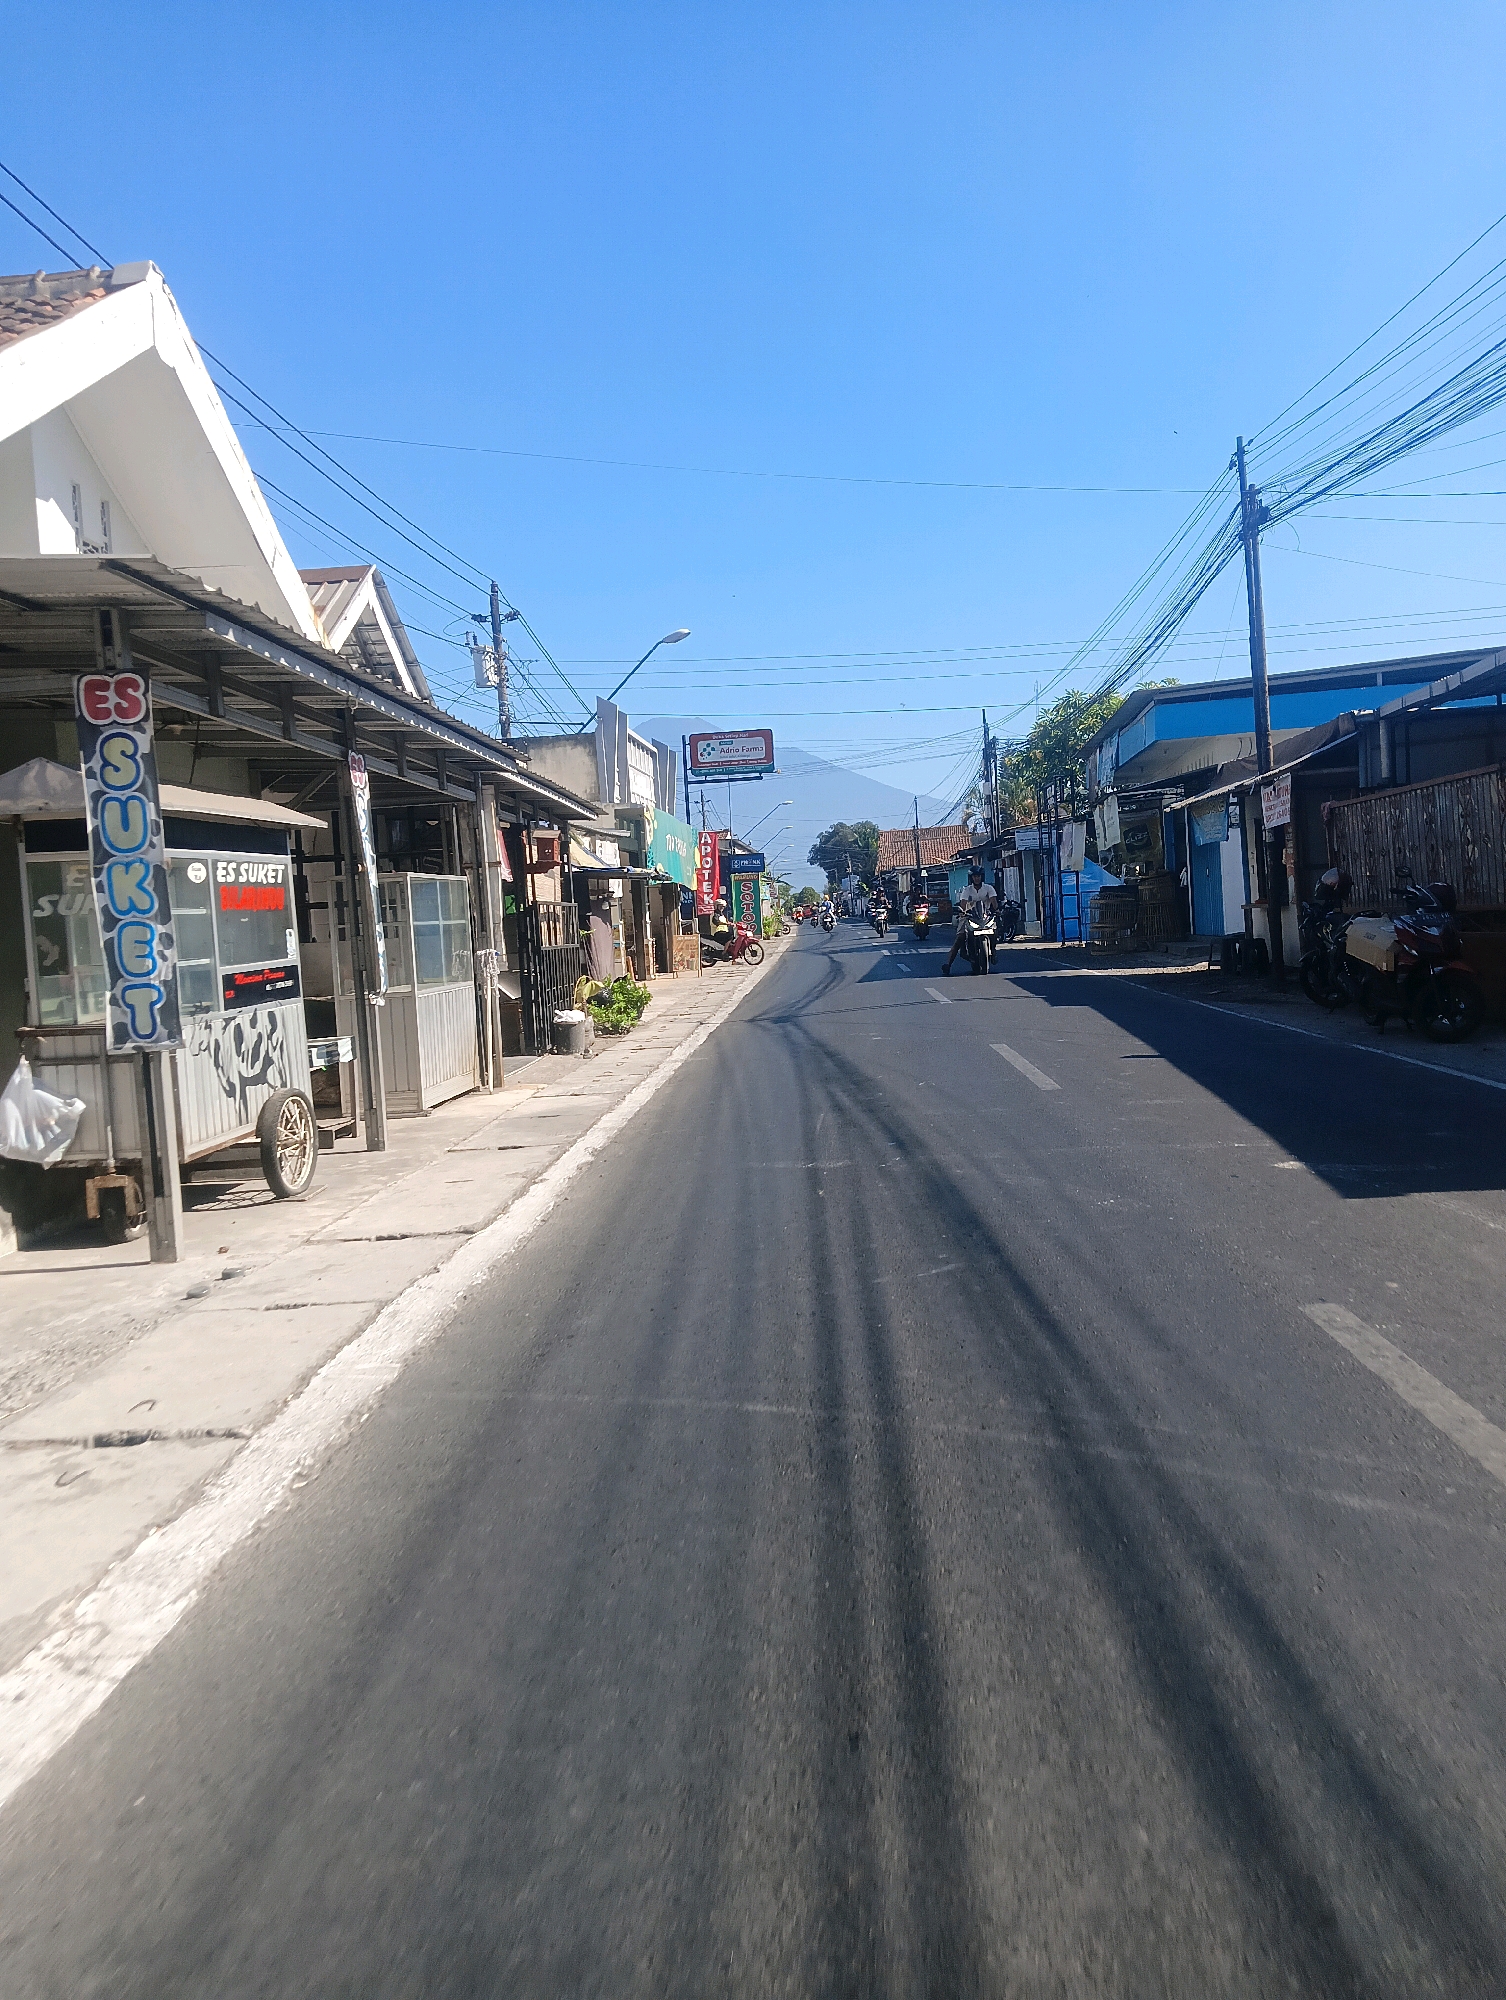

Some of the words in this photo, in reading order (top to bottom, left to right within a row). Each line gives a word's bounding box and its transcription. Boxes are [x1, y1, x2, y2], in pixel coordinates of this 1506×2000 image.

[79, 674, 144, 724] ES
[742, 745, 764, 753] Farma
[97, 729, 163, 1041] SUKET
[216, 861, 237, 883] ES
[238, 862, 286, 885] SUKET
[701, 832, 714, 904] APOTEK
[740, 881, 756, 922] SOTO
